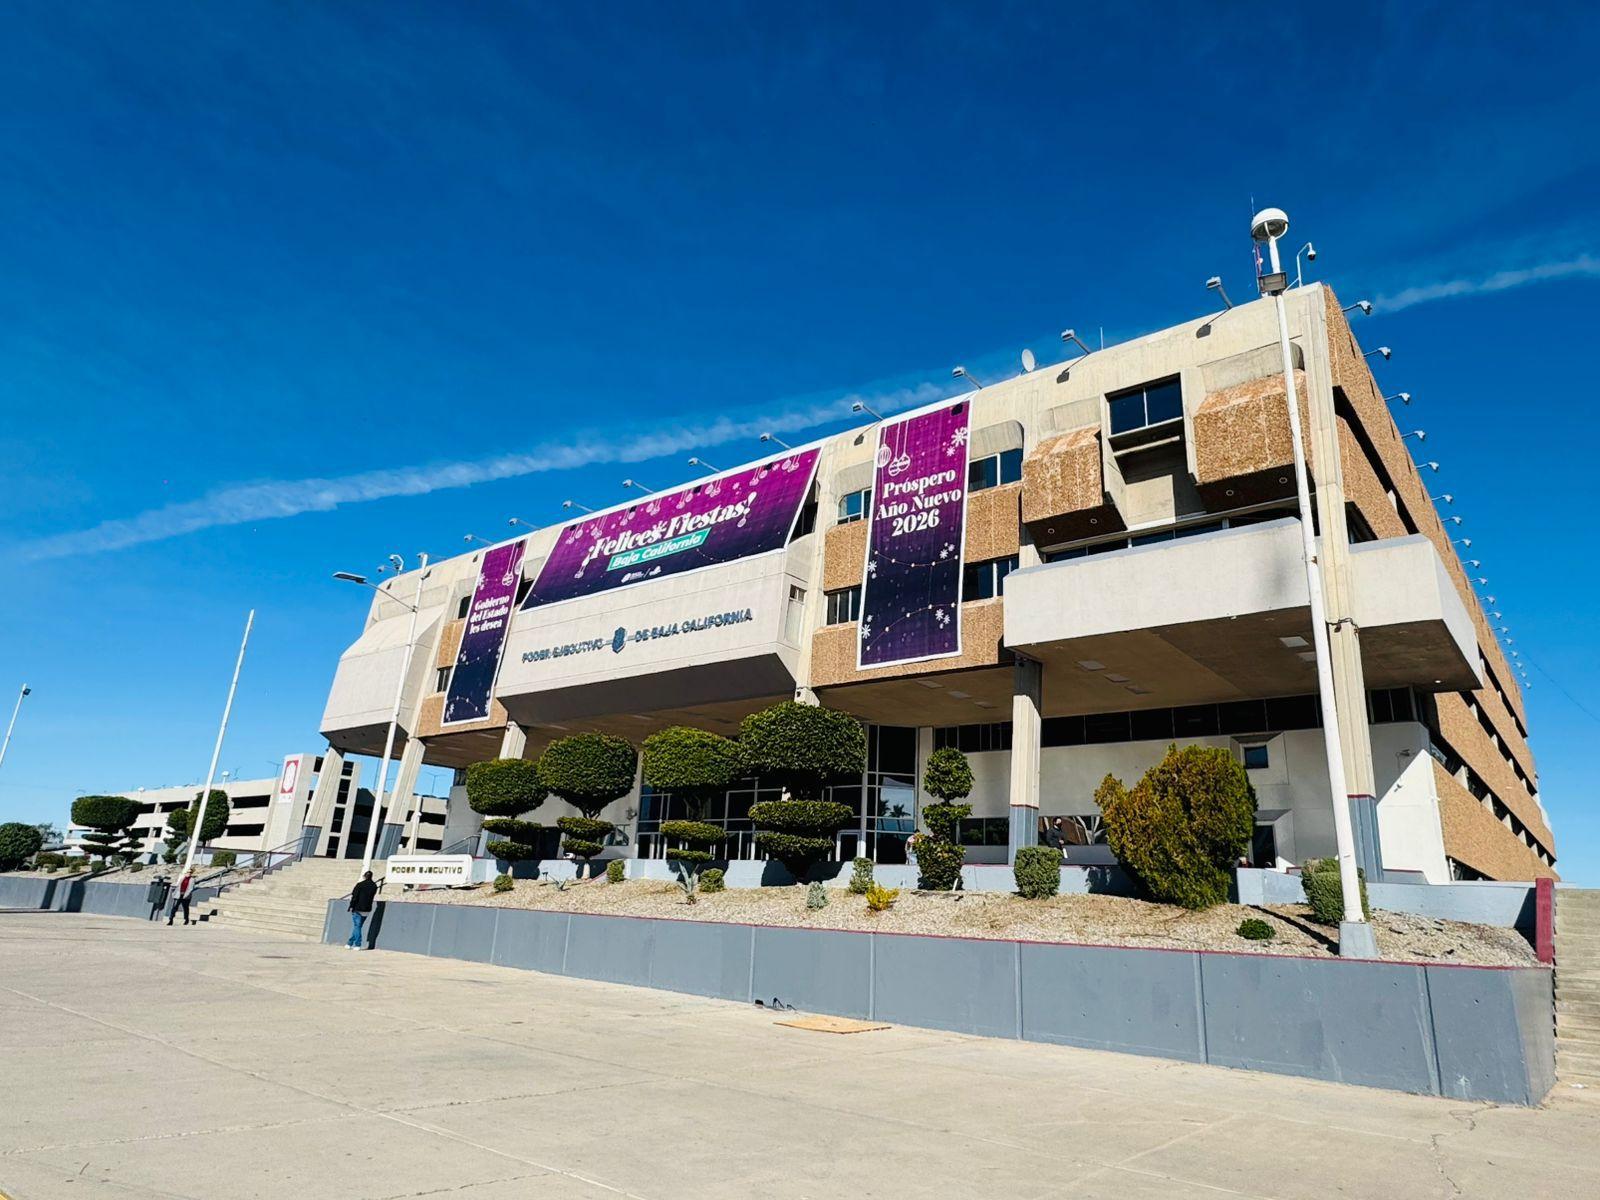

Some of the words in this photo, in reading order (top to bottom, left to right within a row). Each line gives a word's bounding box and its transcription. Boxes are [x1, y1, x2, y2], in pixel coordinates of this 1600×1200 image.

[882, 470, 956, 498] Próspero
[663, 492, 757, 539] Fiestas!
[875, 502, 908, 521] Año
[911, 489, 961, 513] Nuevo
[892, 508, 940, 537] 2026
[612, 552, 640, 567] Baja
[642, 534, 702, 558] California
[470, 610, 483, 623] del
[482, 605, 508, 620] Estado
[475, 595, 509, 610] Gobierno
[469, 623, 480, 634] les
[522, 648, 550, 663] PODER
[552, 638, 603, 658] EJECUTIVO
[635, 629, 649, 642] DE
[651, 622, 680, 640] BAJA
[682, 608, 753, 633] CALIFORNIA
[391, 866, 416, 874] PODER
[418, 866, 463, 874] EJECUTIVO
